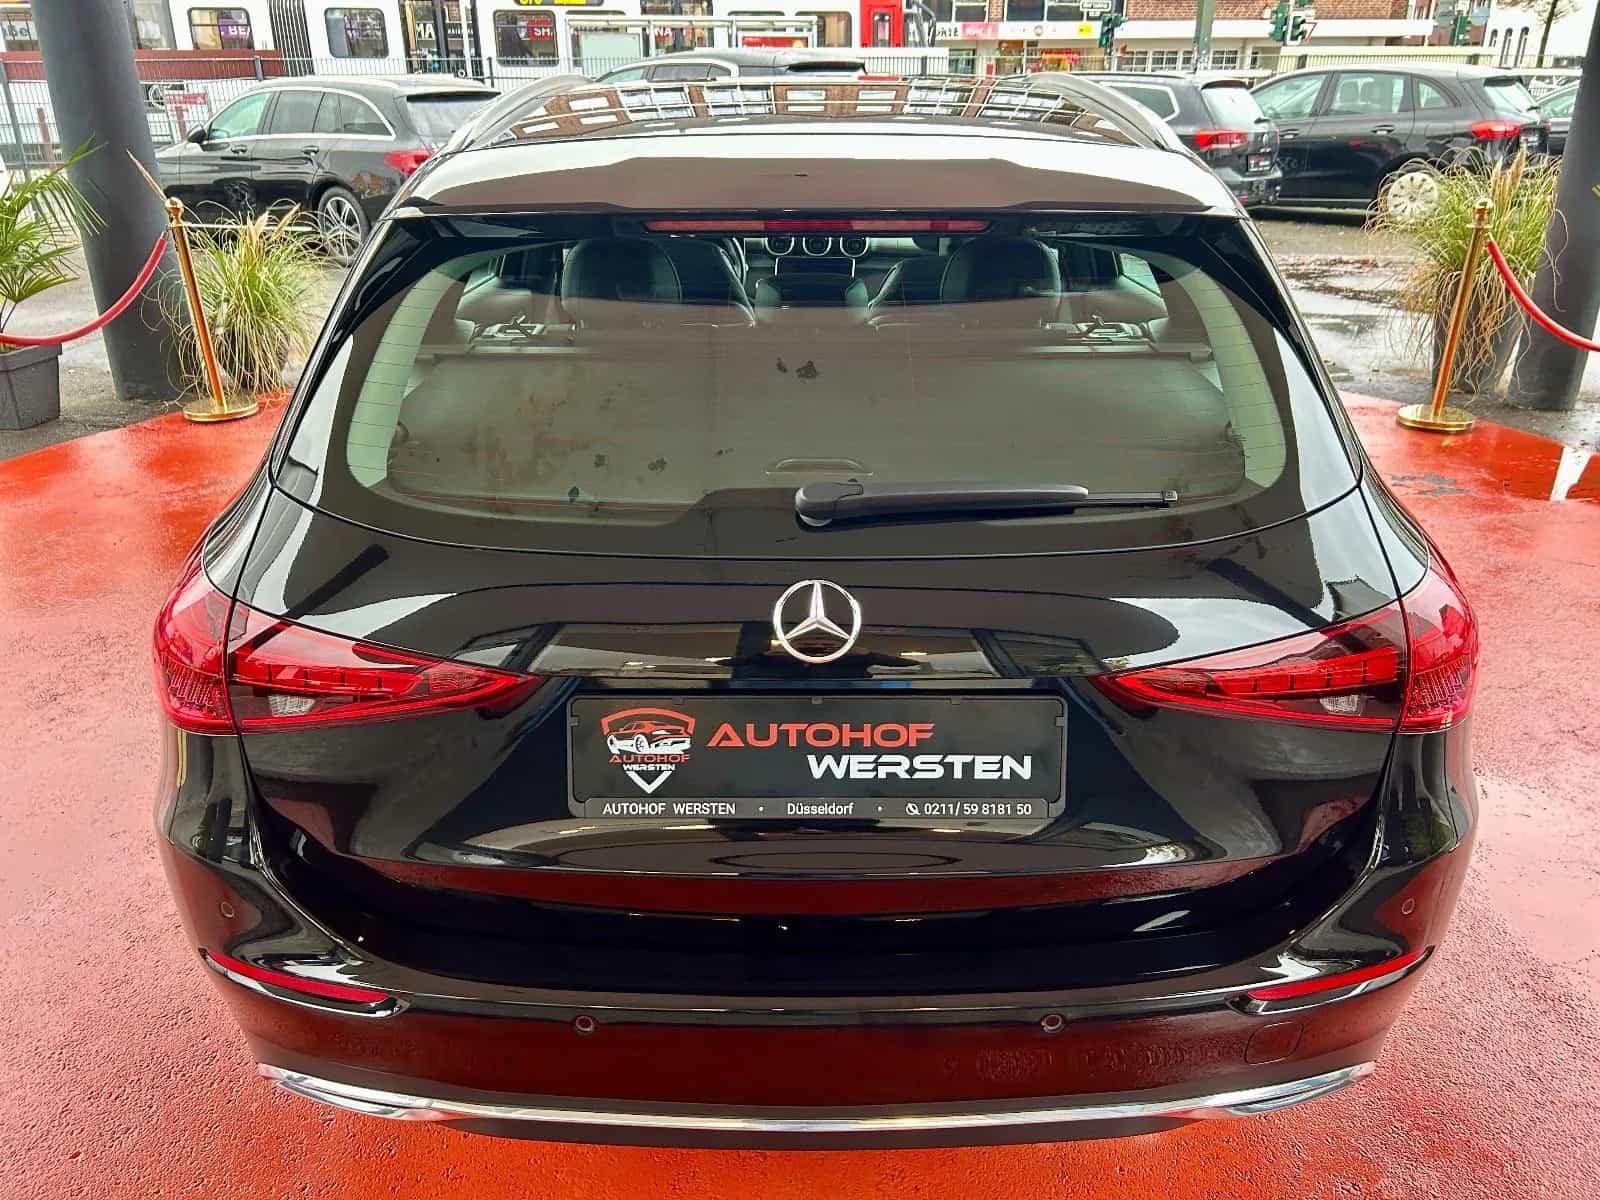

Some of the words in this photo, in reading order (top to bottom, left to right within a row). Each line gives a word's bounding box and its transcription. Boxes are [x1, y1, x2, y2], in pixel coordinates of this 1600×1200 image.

[707, 722, 935, 747] AUTOHOF
[609, 754, 690, 763] AUTOHOF
[622, 763, 676, 771] WERSTEN
[807, 754, 1033, 780] WERSTEN
[602, 802, 666, 815] AUTOHOF
[673, 802, 736, 815] WERSTEN
[787, 801, 855, 816] Düsseldorf
[924, 802, 960, 817] 0211/
[963, 802, 979, 816] 59
[981, 802, 1011, 816] 8181
[1016, 802, 1032, 816] 50
